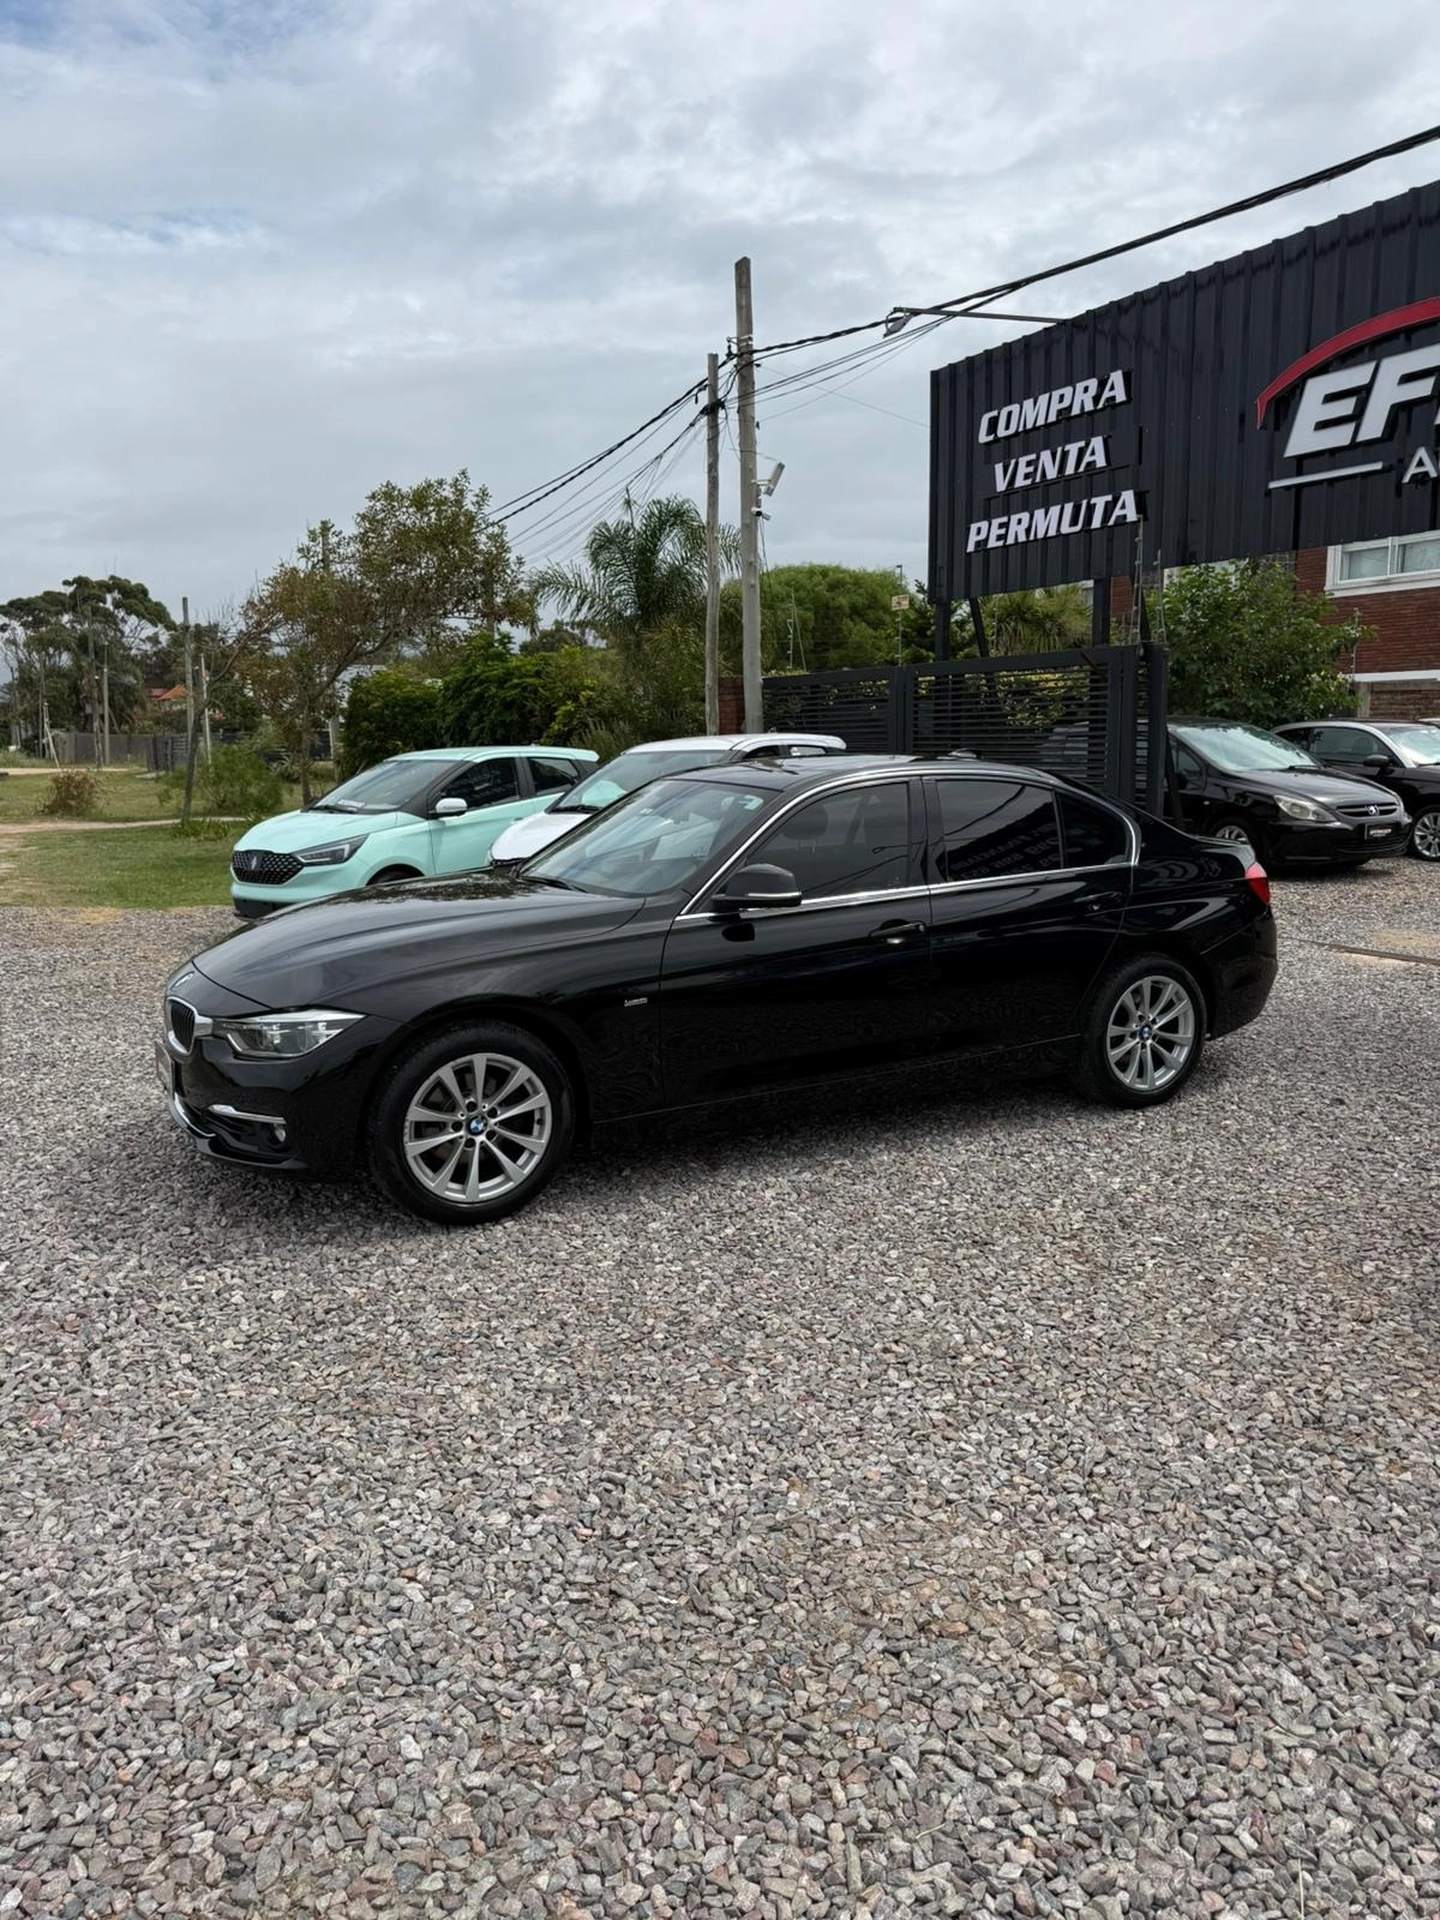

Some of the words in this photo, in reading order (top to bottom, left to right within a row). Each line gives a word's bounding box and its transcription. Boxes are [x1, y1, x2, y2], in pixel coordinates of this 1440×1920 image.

[978, 369, 1127, 444] COMPRA
[1283, 341, 1440, 458] EF
[994, 435, 1107, 493] VENTA
[966, 489, 1139, 553] PERMUTA
